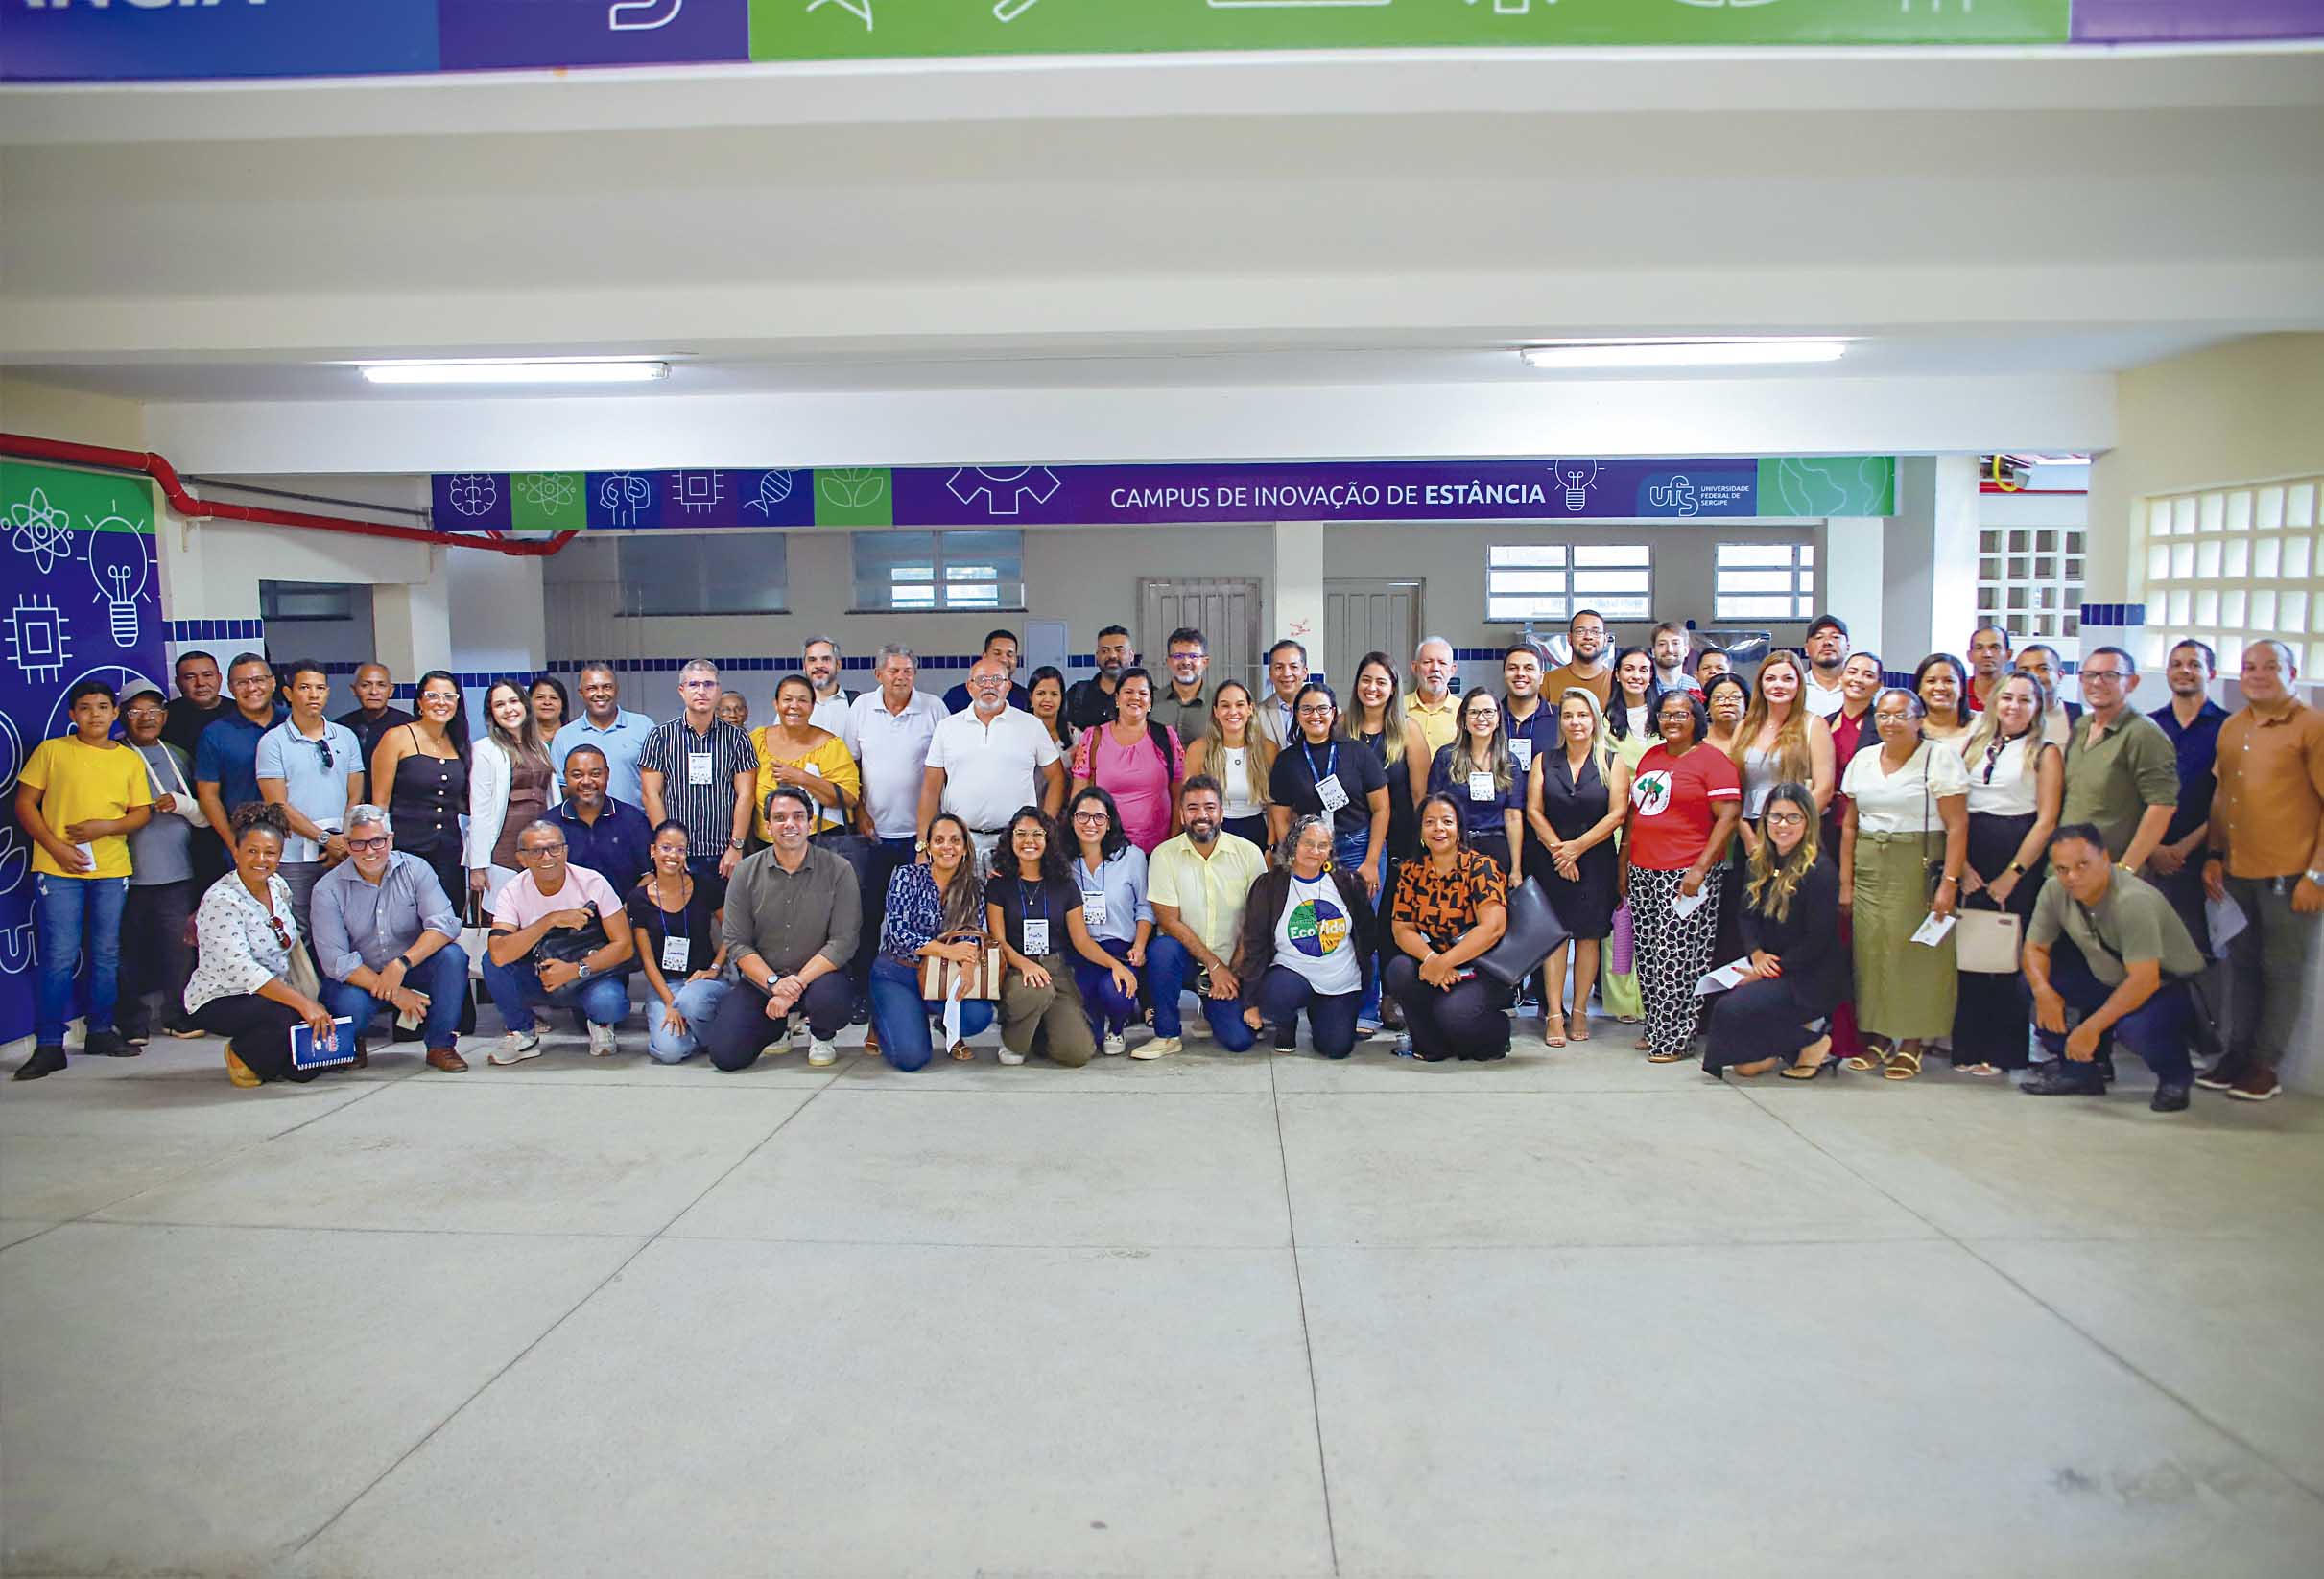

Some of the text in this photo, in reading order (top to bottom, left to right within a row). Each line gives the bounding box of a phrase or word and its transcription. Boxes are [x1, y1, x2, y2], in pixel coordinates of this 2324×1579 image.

[1110, 480, 1546, 509] CAMPUS DE INOVAÇÃO DE ESTÂNCIA
